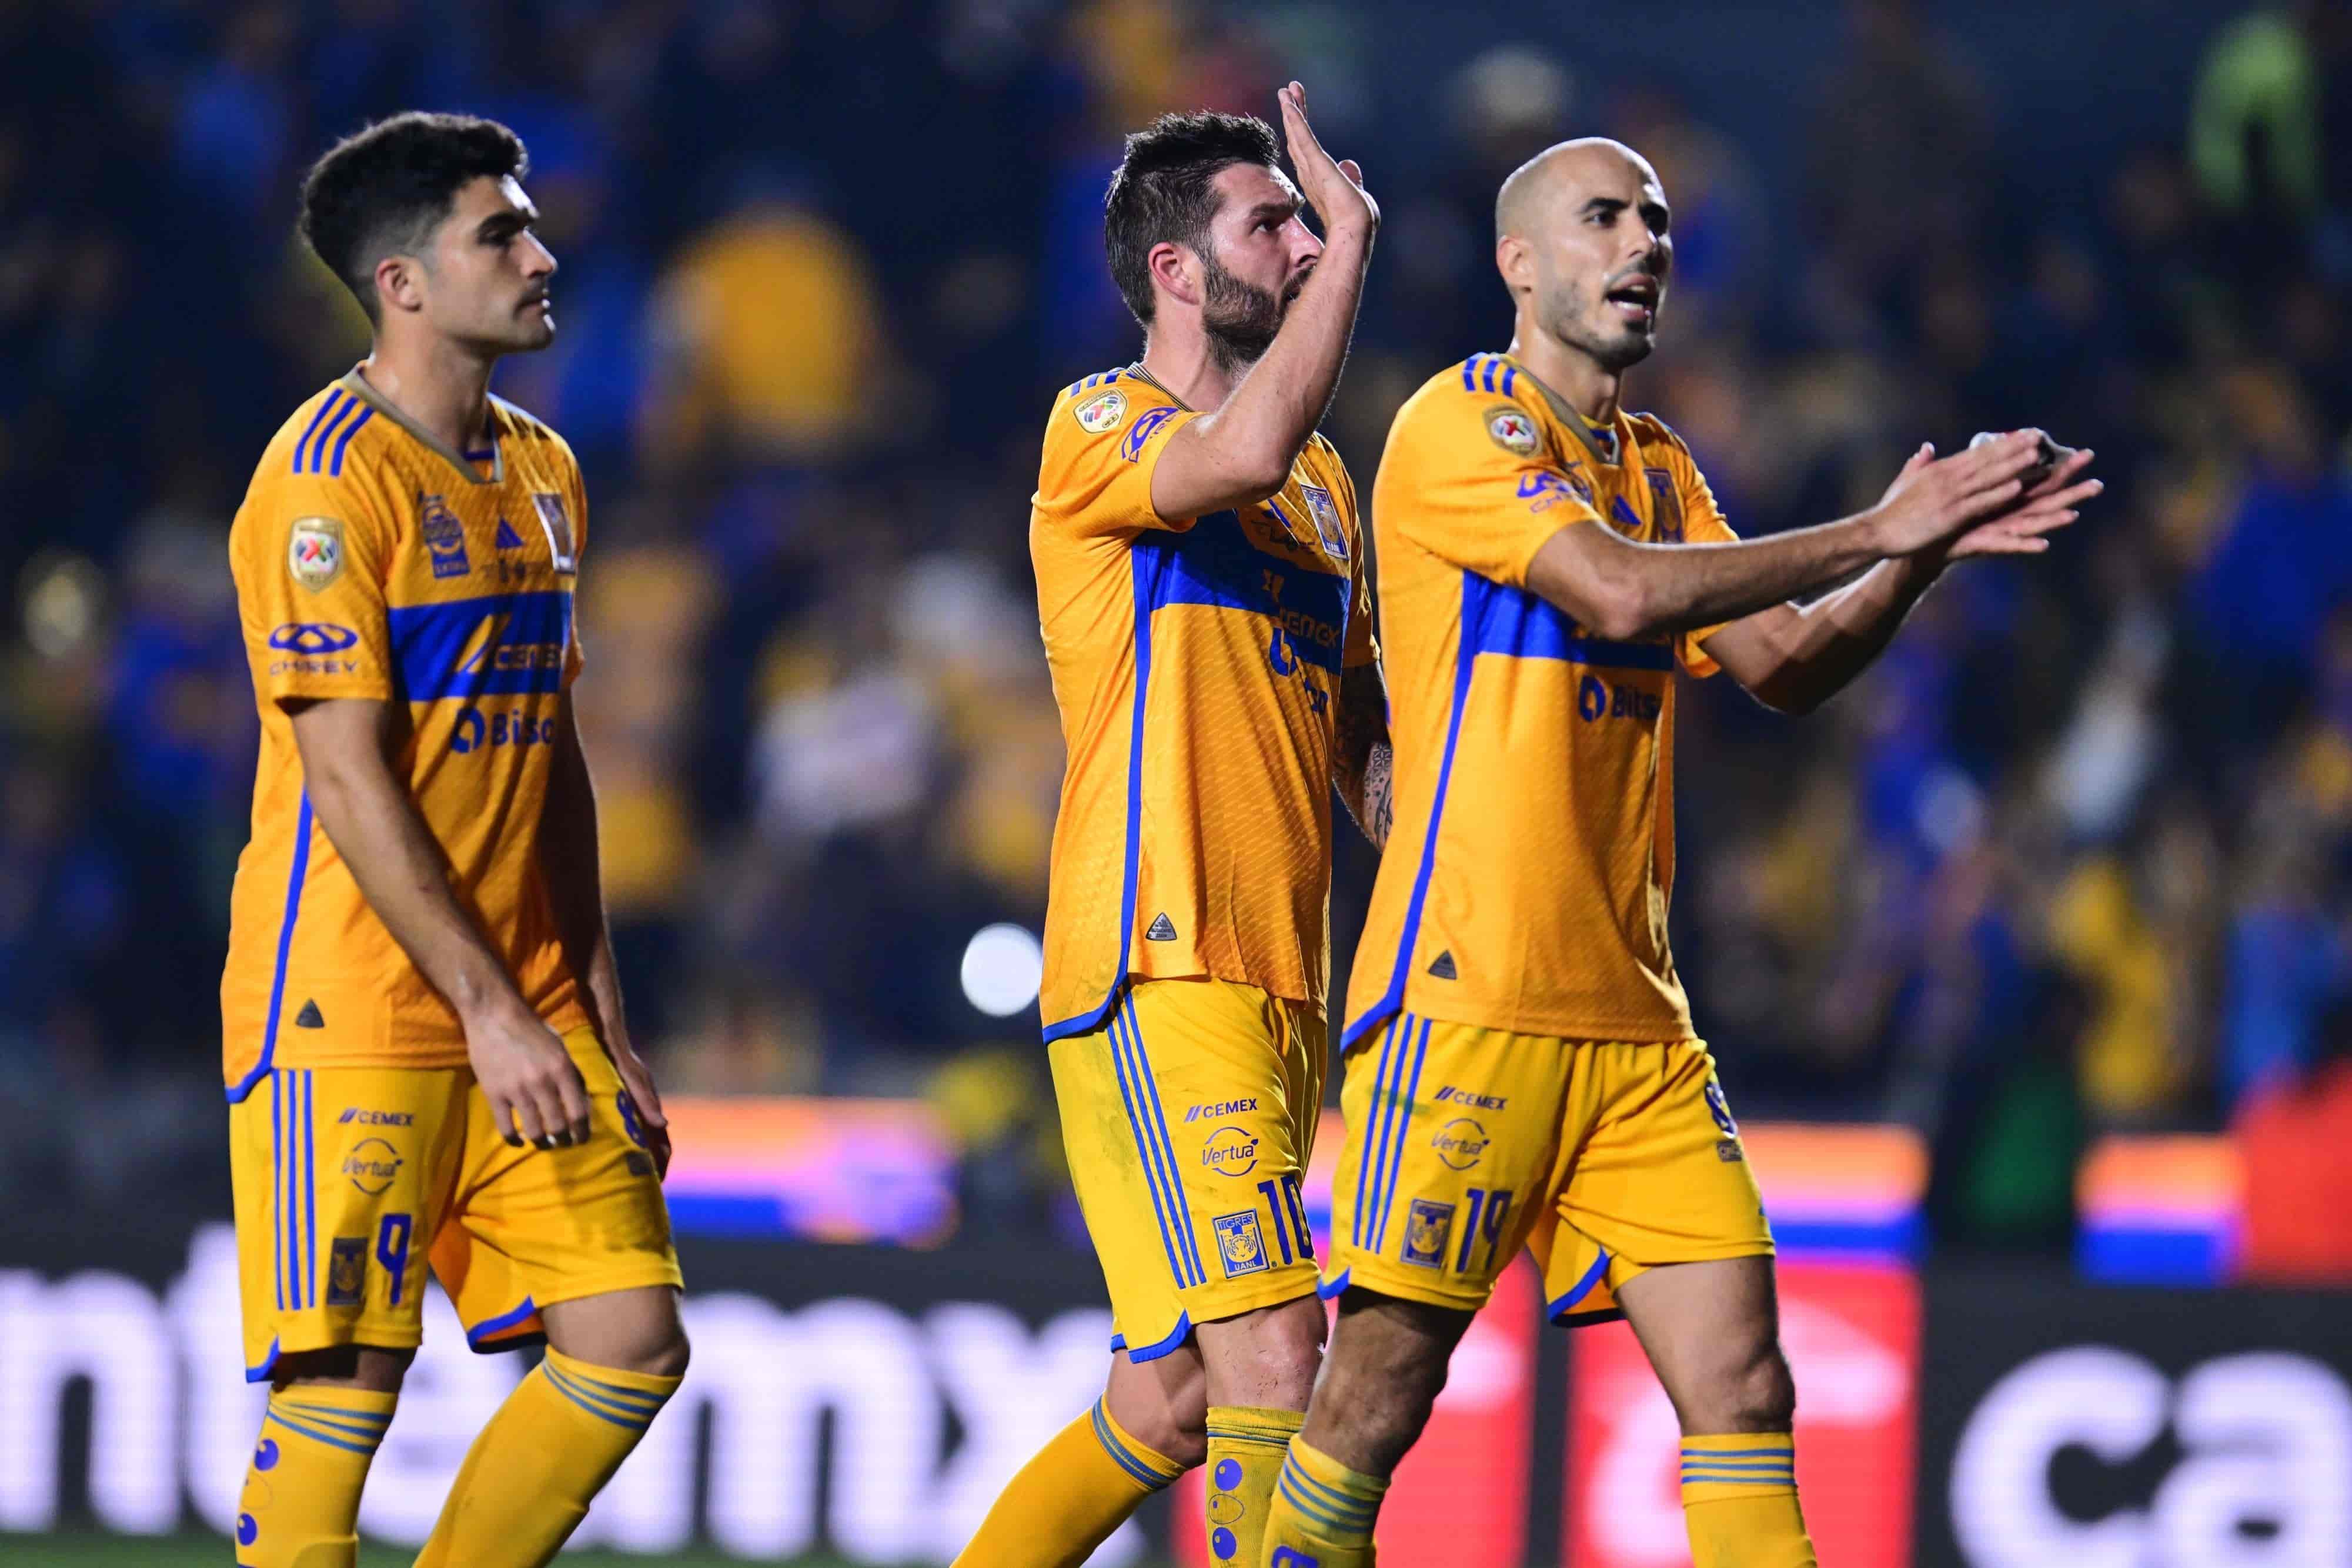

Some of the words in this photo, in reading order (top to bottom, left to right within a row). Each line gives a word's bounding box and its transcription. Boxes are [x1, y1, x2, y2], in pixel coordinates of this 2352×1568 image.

[1203, 1098, 1258, 1118] CEMEX
[1454, 1092, 1508, 1110] CEMEX
[358, 1110, 413, 1126] CEMEX
[1432, 1131, 1484, 1155] Vertua
[1202, 1145, 1254, 1165] Vertua
[342, 1156, 396, 1177] Vertua
[1218, 1213, 1254, 1231] TIGRES
[1257, 1172, 1314, 1265] 10
[1455, 1188, 1514, 1273] 19
[376, 1213, 412, 1305] 9
[1234, 1261, 1257, 1271] UANL
[1949, 1345, 2352, 1568] ca
